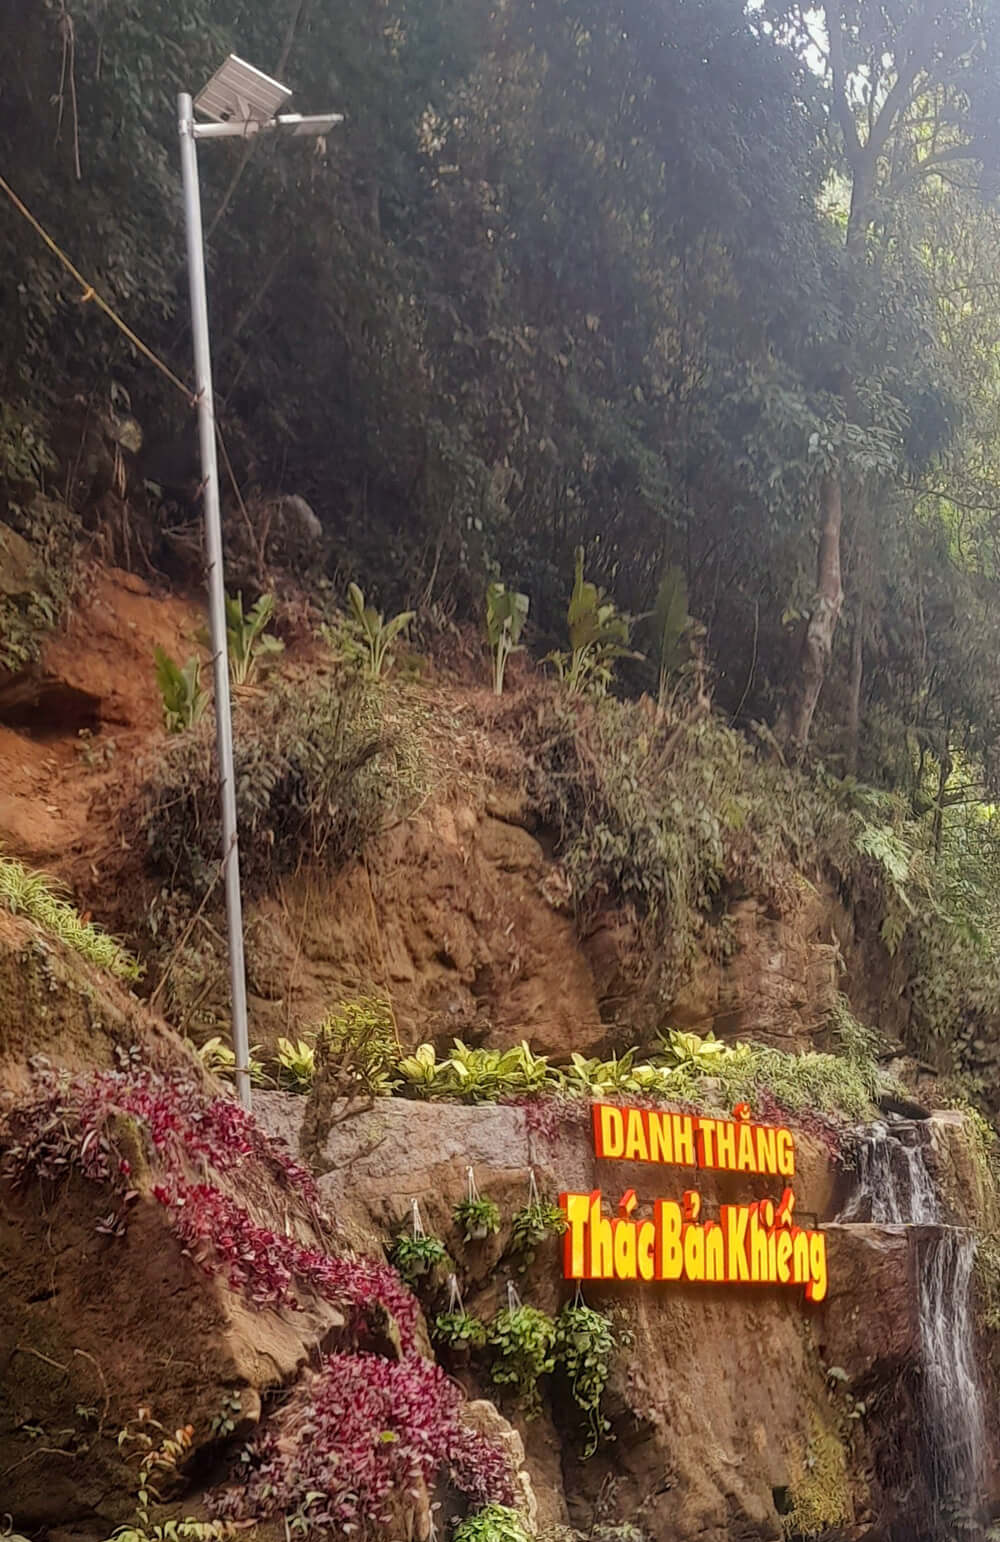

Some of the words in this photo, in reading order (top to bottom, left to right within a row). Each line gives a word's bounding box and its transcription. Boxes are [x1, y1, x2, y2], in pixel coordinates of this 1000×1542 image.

[598, 1104, 695, 1165] DANH
[698, 1104, 795, 1176] THẮNG
[564, 1191, 655, 1281] Thác
[657, 1191, 723, 1281] Bản
[724, 1189, 828, 1302] Khiếng
